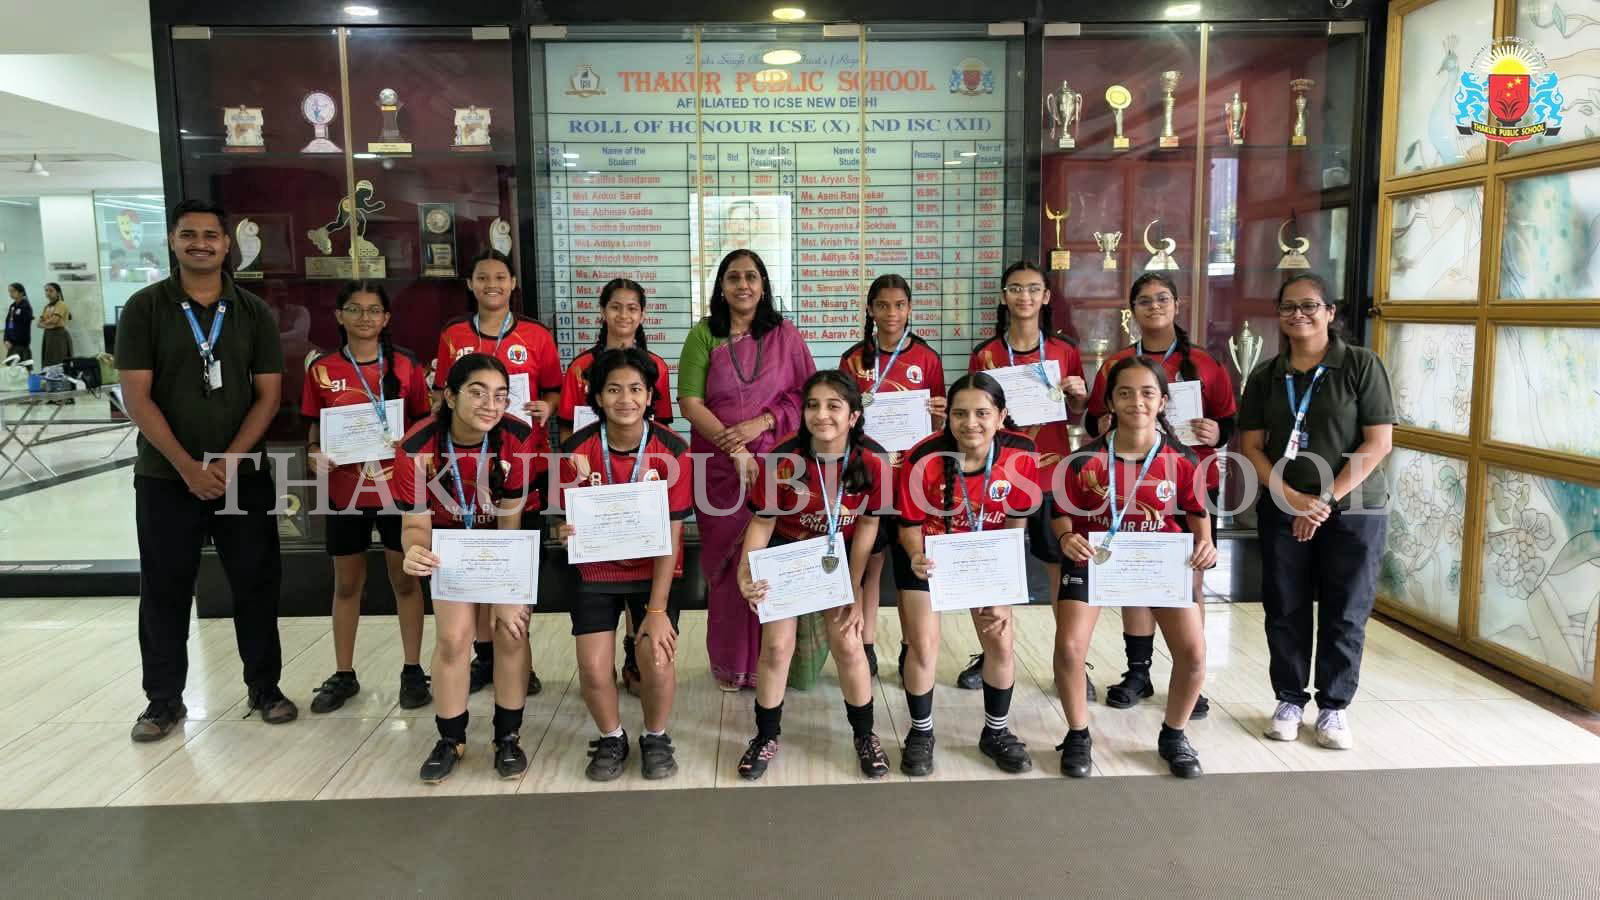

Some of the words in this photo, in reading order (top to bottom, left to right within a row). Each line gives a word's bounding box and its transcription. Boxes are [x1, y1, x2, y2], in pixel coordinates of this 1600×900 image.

[617, 71, 722, 94] THAKUR
[736, 70, 824, 93] PUBLIC
[836, 69, 936, 92] SCHOOL
[677, 97, 749, 108] AFILIATED
[753, 97, 770, 108] TO
[774, 97, 802, 108] ICSE
[807, 97, 836, 107] NEW
[569, 120, 628, 133] ROLL
[633, 120, 663, 133] OF
[669, 120, 762, 133] HONOUR
[769, 120, 817, 133] ICSE
[822, 120, 850, 133] (X)
[857, 119, 900, 132] AND
[907, 118, 941, 131] ISC
[947, 117, 991, 132] (XII)
[602, 147, 624, 155] Name
[821, 300, 848, 310] Nisarg
[560, 316, 571, 326] 10
[560, 331, 571, 341] 11
[821, 330, 848, 339] Aarav
[331, 379, 347, 392] 31
